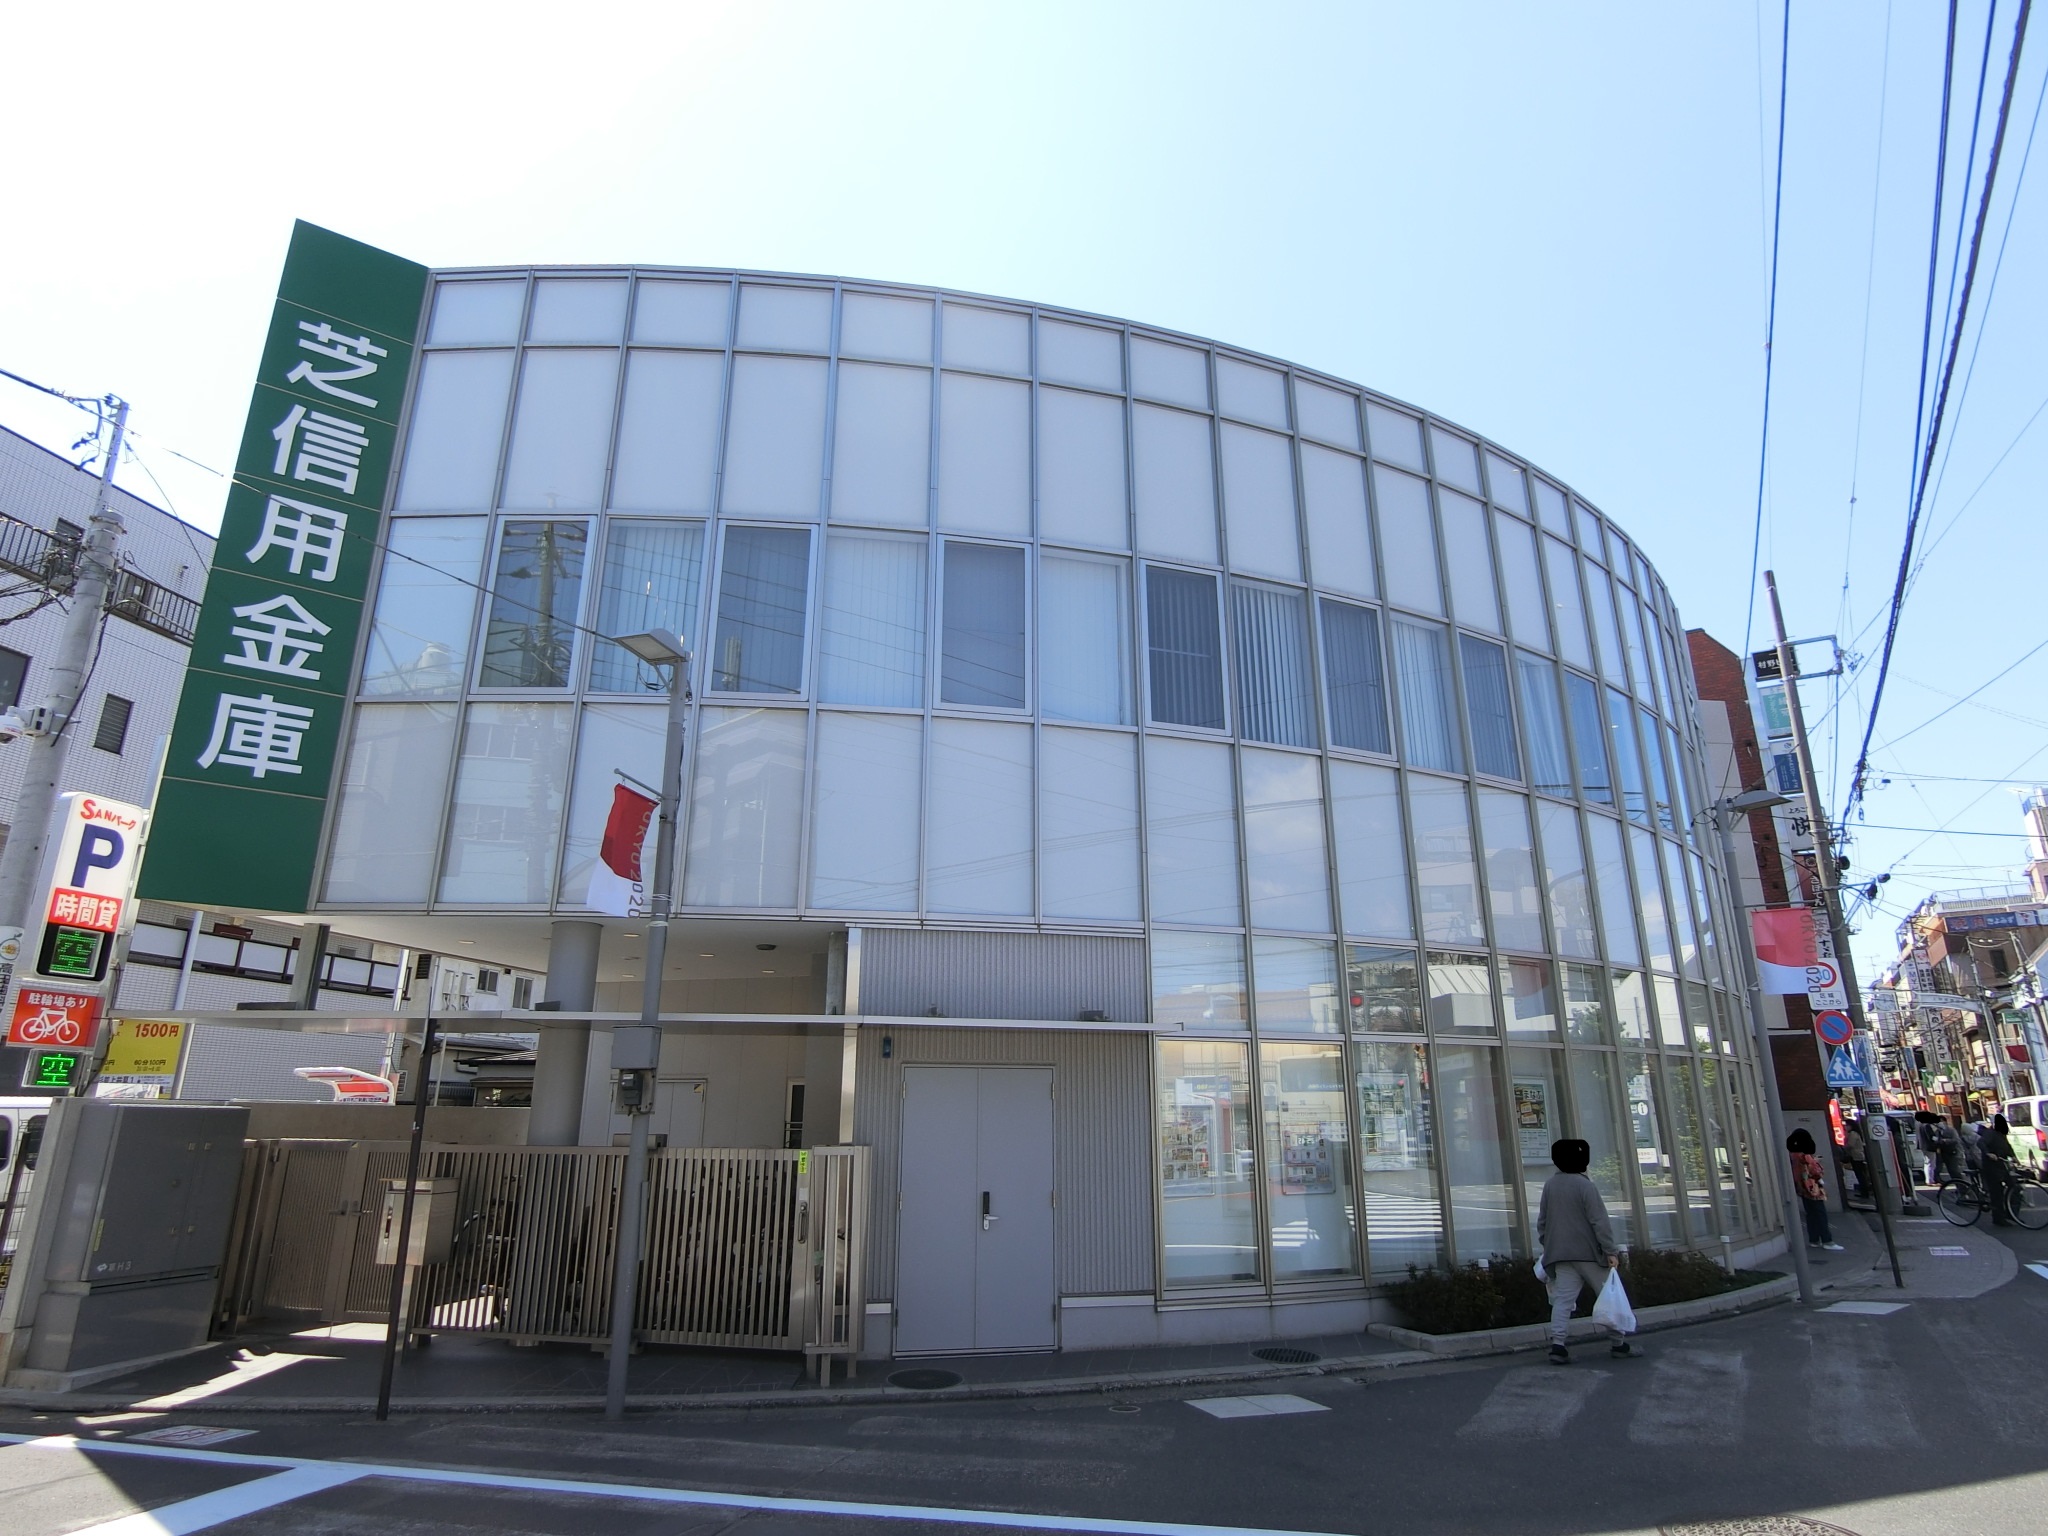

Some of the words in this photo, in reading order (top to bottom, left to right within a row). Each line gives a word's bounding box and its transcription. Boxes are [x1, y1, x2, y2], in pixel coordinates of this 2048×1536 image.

[197, 319, 387, 779] 芝信用金庫
[70, 823, 125, 888] P
[54, 893, 118, 929] 時間貸
[628, 870, 644, 919] 2020
[1800, 914, 1816, 954] OKYO
[28, 992, 88, 1008] 駐輪場あり
[136, 1023, 179, 1038] 1500円
[36, 1054, 75, 1086] 空
